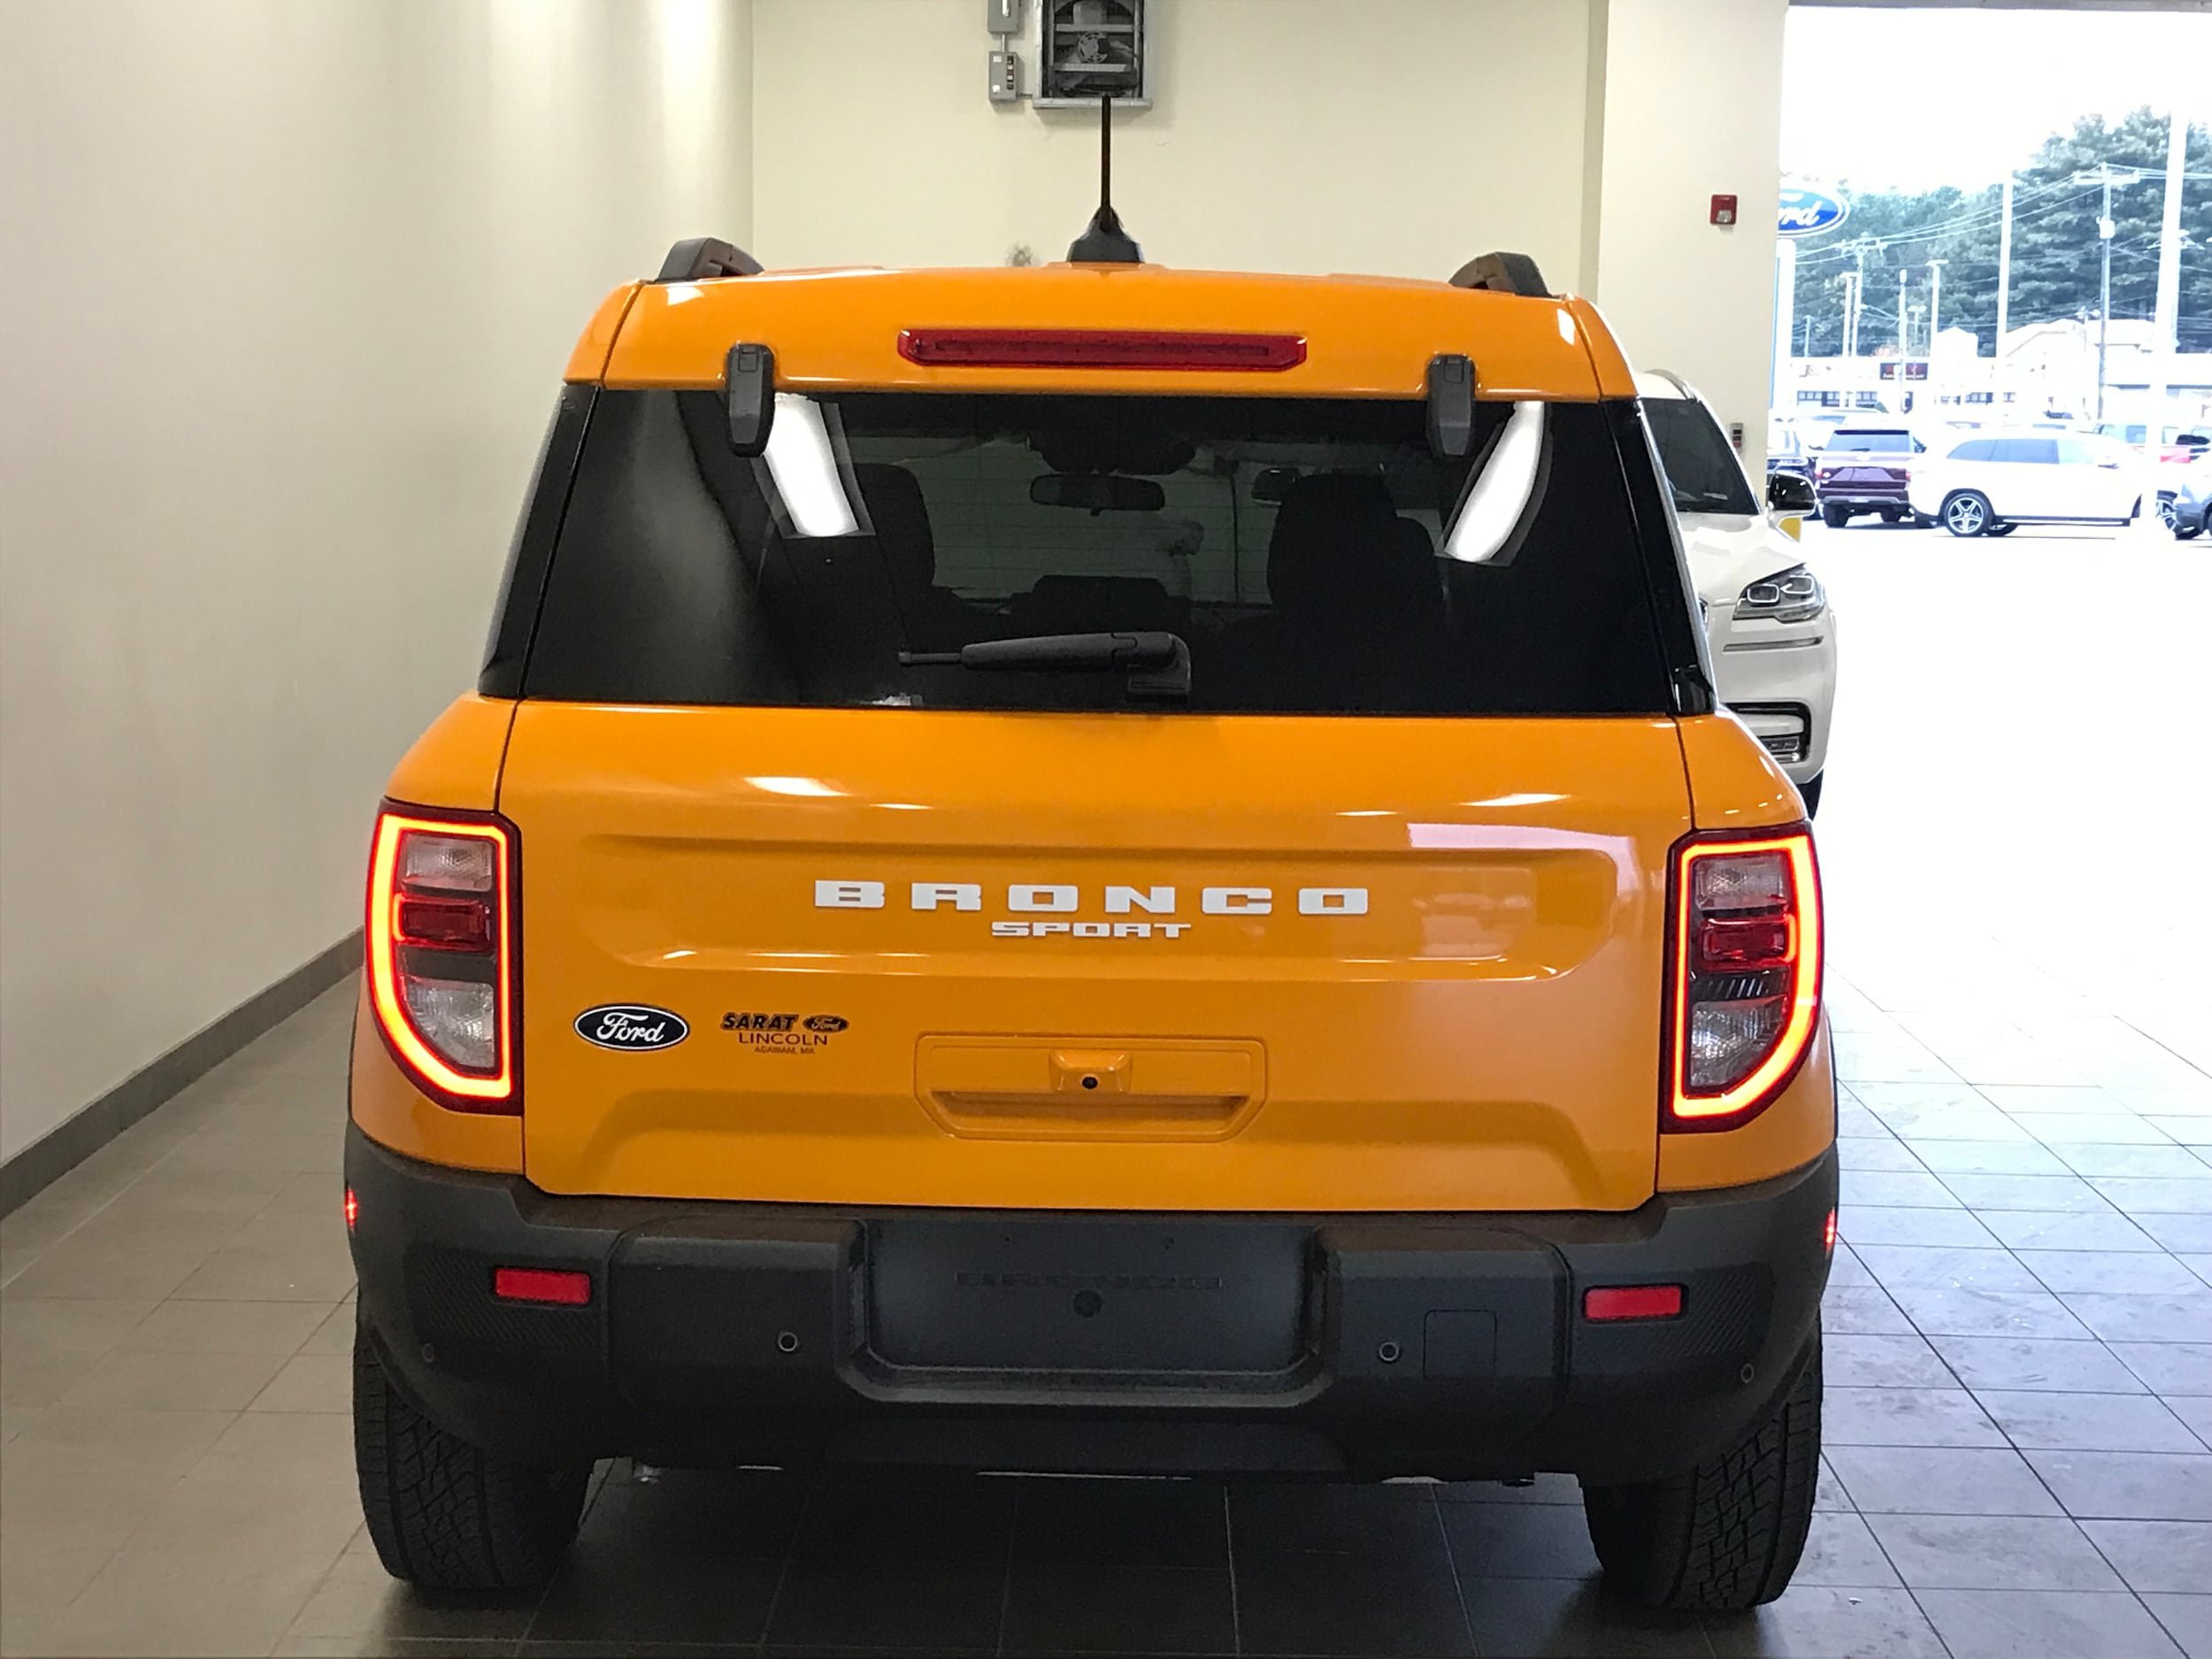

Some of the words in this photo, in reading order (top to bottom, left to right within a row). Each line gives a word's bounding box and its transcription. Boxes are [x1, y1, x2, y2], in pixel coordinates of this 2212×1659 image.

[1778, 192, 1823, 226] rd
[814, 879, 1369, 915] BRONCO
[991, 921, 1192, 938] SPORT
[595, 1011, 665, 1043] Ford
[720, 1011, 799, 1031] SARAT
[738, 1033, 828, 1046] LINCOLN
